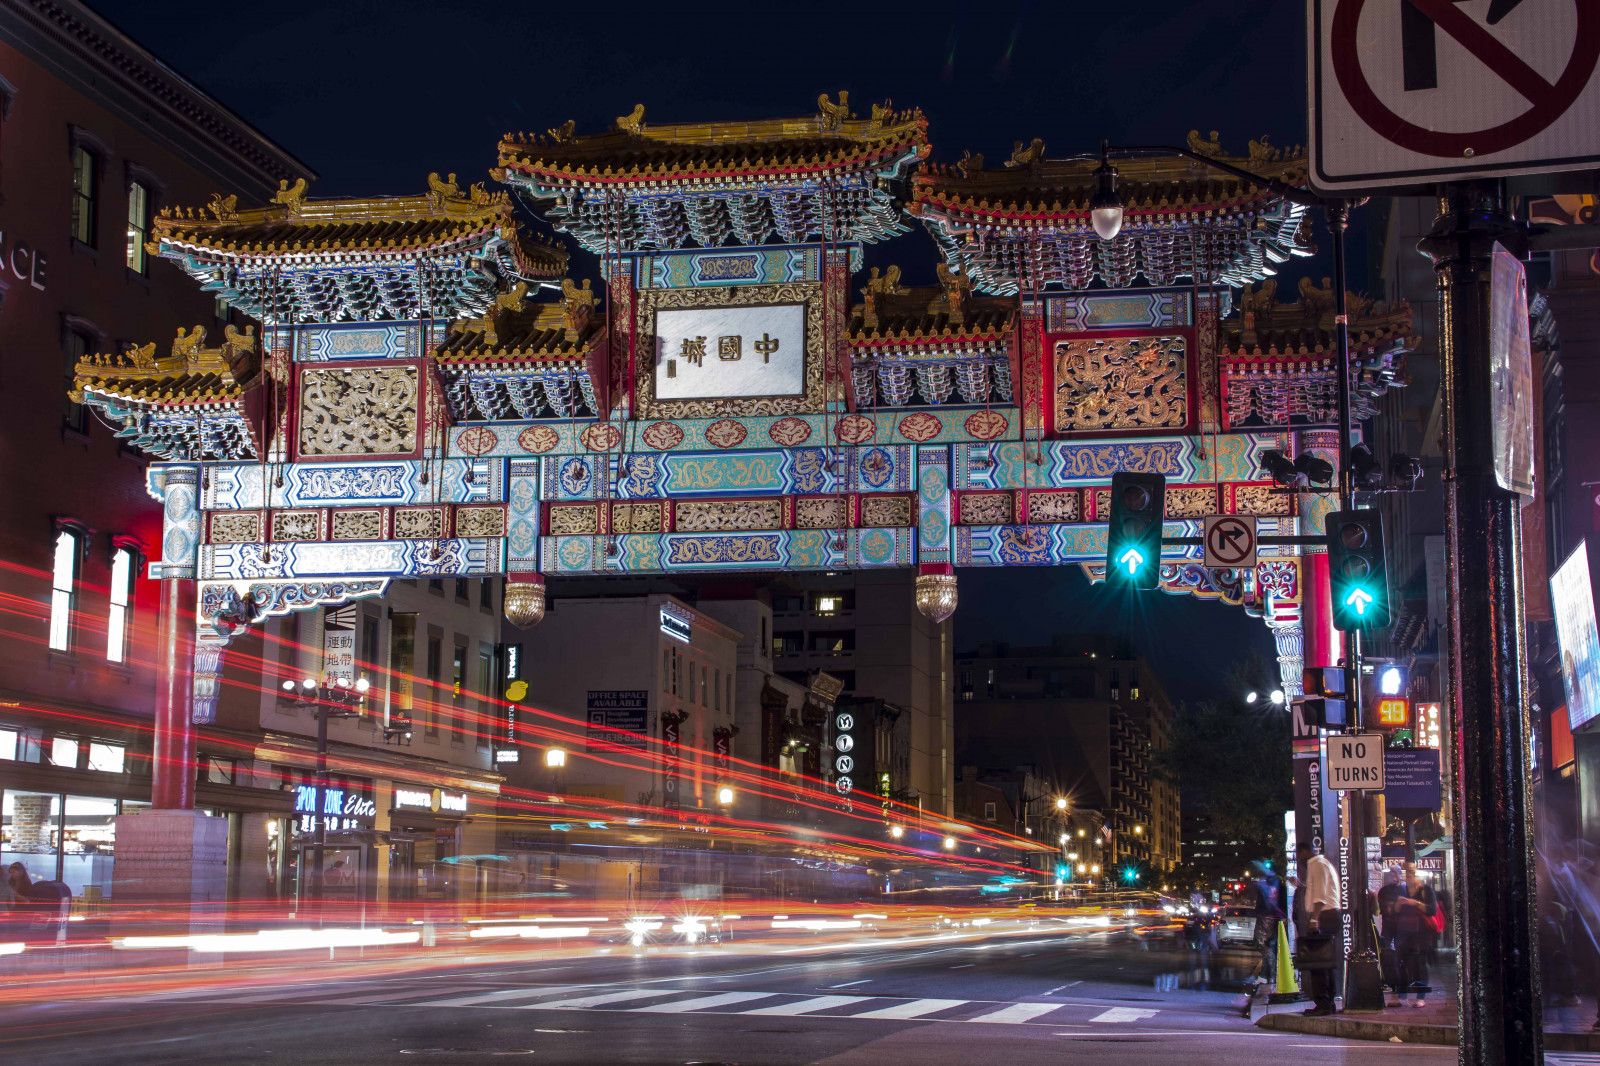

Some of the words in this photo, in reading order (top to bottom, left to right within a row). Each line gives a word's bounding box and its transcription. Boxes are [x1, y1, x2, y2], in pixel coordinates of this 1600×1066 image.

[506, 646, 517, 679] bread
[588, 691, 618, 699] OFFICE
[618, 691, 647, 699] SPACE
[593, 699, 643, 707] AVAILABLE
[508, 704, 516, 744] panera
[1292, 705, 1318, 737] M
[1342, 742, 1366, 758] NO
[1309, 761, 1320, 811] Gallery
[1334, 767, 1378, 782] TURNS
[295, 785, 317, 812] SPOR
[323, 789, 344, 815] ZONE
[343, 794, 376, 817] Elite
[396, 789, 431, 808] panera
[441, 791, 467, 811] bread
[1339, 836, 1350, 911] Chinatown
[1382, 859, 1442, 870] RESTRANT
